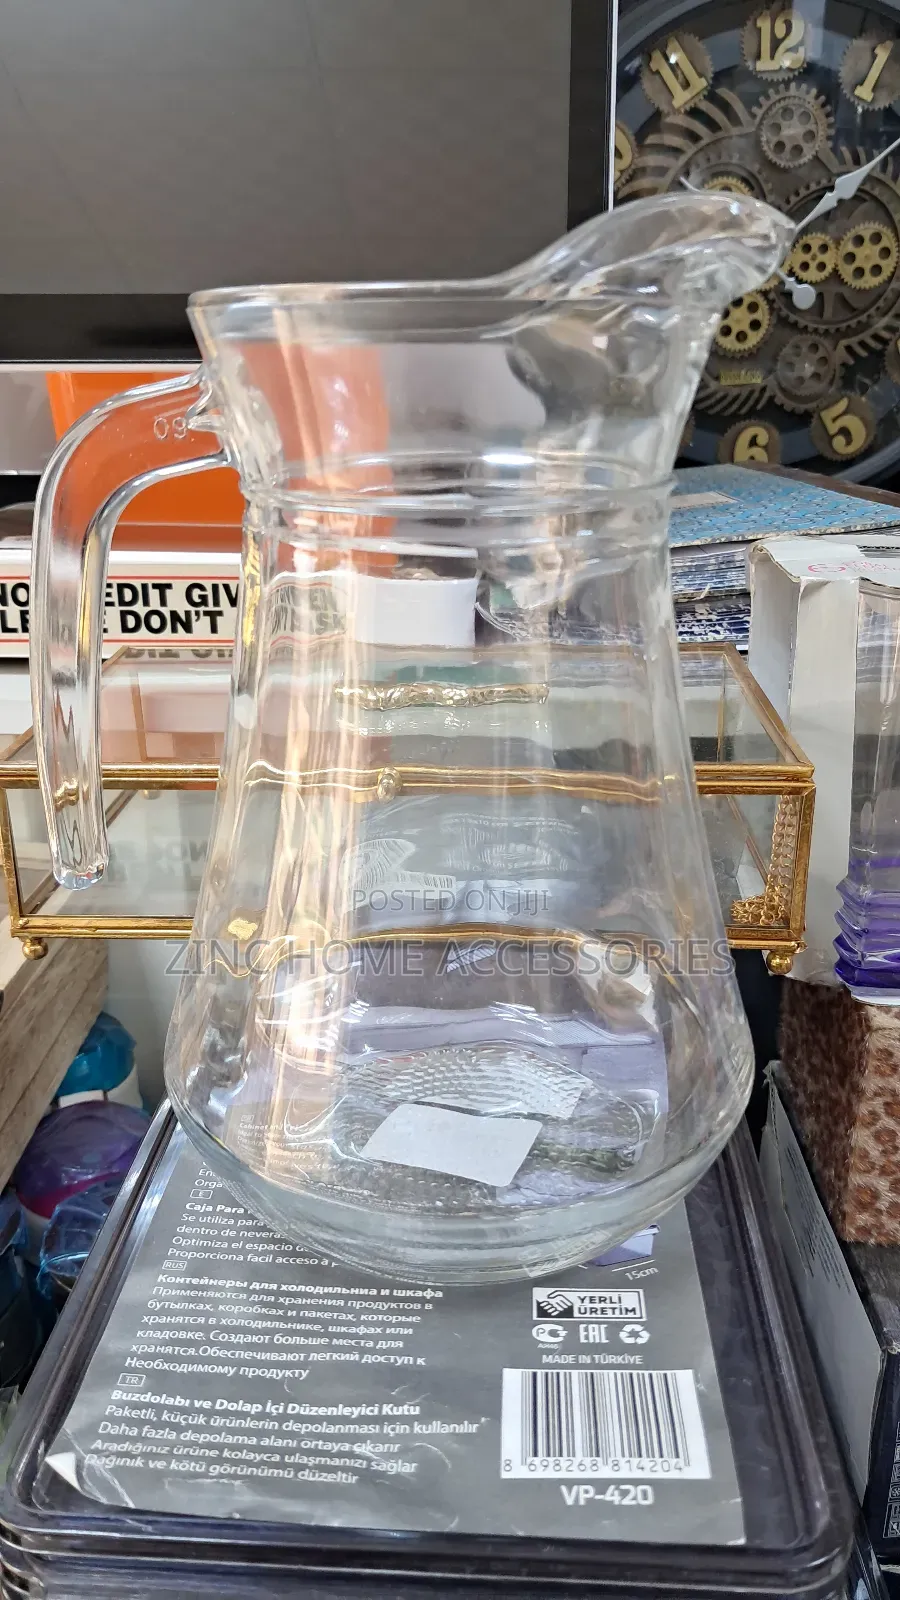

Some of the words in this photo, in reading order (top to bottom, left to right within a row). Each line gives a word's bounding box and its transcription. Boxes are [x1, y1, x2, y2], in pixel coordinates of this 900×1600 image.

[756, 9, 805, 72] 12
[650, 37, 708, 110] 11
[854, 40, 894, 102] 1
[819, 397, 866, 455] 5
[733, 425, 769, 463] 6
[185, 582, 240, 608] GIV
[119, 609, 224, 635] DON'T
[185, 1202, 213, 1213] Caja
[216, 1204, 245, 1214] Para
[176, 1225, 218, 1236] dentro
[221, 1226, 237, 1237] de
[181, 1213, 196, 1222] Se
[199, 1214, 235, 1225] utiliza
[237, 1218, 264, 1227] para
[172, 1236, 228, 1249] Optimiza
[231, 1240, 243, 1250] el
[245, 1242, 293, 1253] espacio
[165, 1261, 185, 1270] RUS
[167, 1248, 244, 1261] Proporciona
[247, 1253, 273, 1263] facil
[275, 1257, 319, 1266] acceso
[625, 1266, 659, 1281] 15cm
[157, 1274, 248, 1289] Контейнеры
[249, 1281, 278, 1291] для
[280, 1283, 377, 1296] холодильниа
[380, 1288, 390, 1296] и
[393, 1288, 444, 1299] шкафа
[152, 1286, 247, 1300] Применяются
[248, 1292, 275, 1302] для
[277, 1296, 345, 1306] хранения
[347, 1300, 422, 1311] продуктов
[577, 1293, 622, 1304] YERLİ
[577, 1304, 637, 1316] ÜRETİM
[147, 1300, 214, 1312] бутылках,
[218, 1304, 285, 1317] коробках
[287, 1309, 297, 1317] и
[299, 1310, 357, 1322] пакетах,
[360, 1313, 422, 1324] которые
[141, 1315, 205, 1325] хранятся
[208, 1317, 217, 1325] в
[219, 1317, 325, 1333] холодильнике,
[327, 1325, 383, 1336] шкафах
[385, 1327, 414, 1335] или
[209, 1329, 272, 1344] Создают
[273, 1333, 330, 1345] больше
[332, 1338, 375, 1348] места
[376, 1339, 404, 1349] для
[124, 1356, 237, 1377] Необходимому
[239, 1366, 310, 1381] продукту
[308, 1351, 360, 1362] легкий
[361, 1354, 414, 1366] доступ
[416, 1356, 427, 1366] к
[542, 1354, 577, 1364] MADE
[578, 1354, 591, 1364] IN
[594, 1353, 644, 1365] TÜRKİYE
[124, 1375, 139, 1385] TR
[111, 1389, 190, 1407] Buzdolabı
[194, 1400, 213, 1409] ve
[215, 1398, 263, 1415] Dolap
[265, 1398, 284, 1416] İçi
[286, 1403, 379, 1419] Düzenleyici
[381, 1403, 421, 1416] Kutu
[105, 1405, 157, 1422] Paketli,
[161, 1409, 207, 1426] küçük
[210, 1415, 279, 1430] ürünlerin
[282, 1420, 380, 1435] depolanması
[382, 1421, 410, 1437] için
[413, 1420, 479, 1434] kullanılır
[98, 1421, 139, 1436] Daha
[141, 1424, 176, 1440] fazla
[180, 1429, 257, 1445] depolama
[260, 1436, 297, 1448] alanı
[300, 1437, 350, 1453] ortaya
[91, 1439, 171, 1455] Aradığınız
[173, 1444, 220, 1458] ürüne
[222, 1446, 281, 1463] kolayca
[284, 1452, 367, 1468] ulaşmanızı
[370, 1459, 419, 1475] sağlar
[503, 1459, 513, 1473] 8
[528, 1459, 600, 1473] 698268
[611, 1459, 684, 1473] 814204
[148, 1459, 167, 1469] ve
[169, 1459, 206, 1472] kötü
[208, 1463, 294, 1478] görünümü
[297, 1469, 360, 1484] düzeltir
[560, 1484, 655, 1506] VP-420
